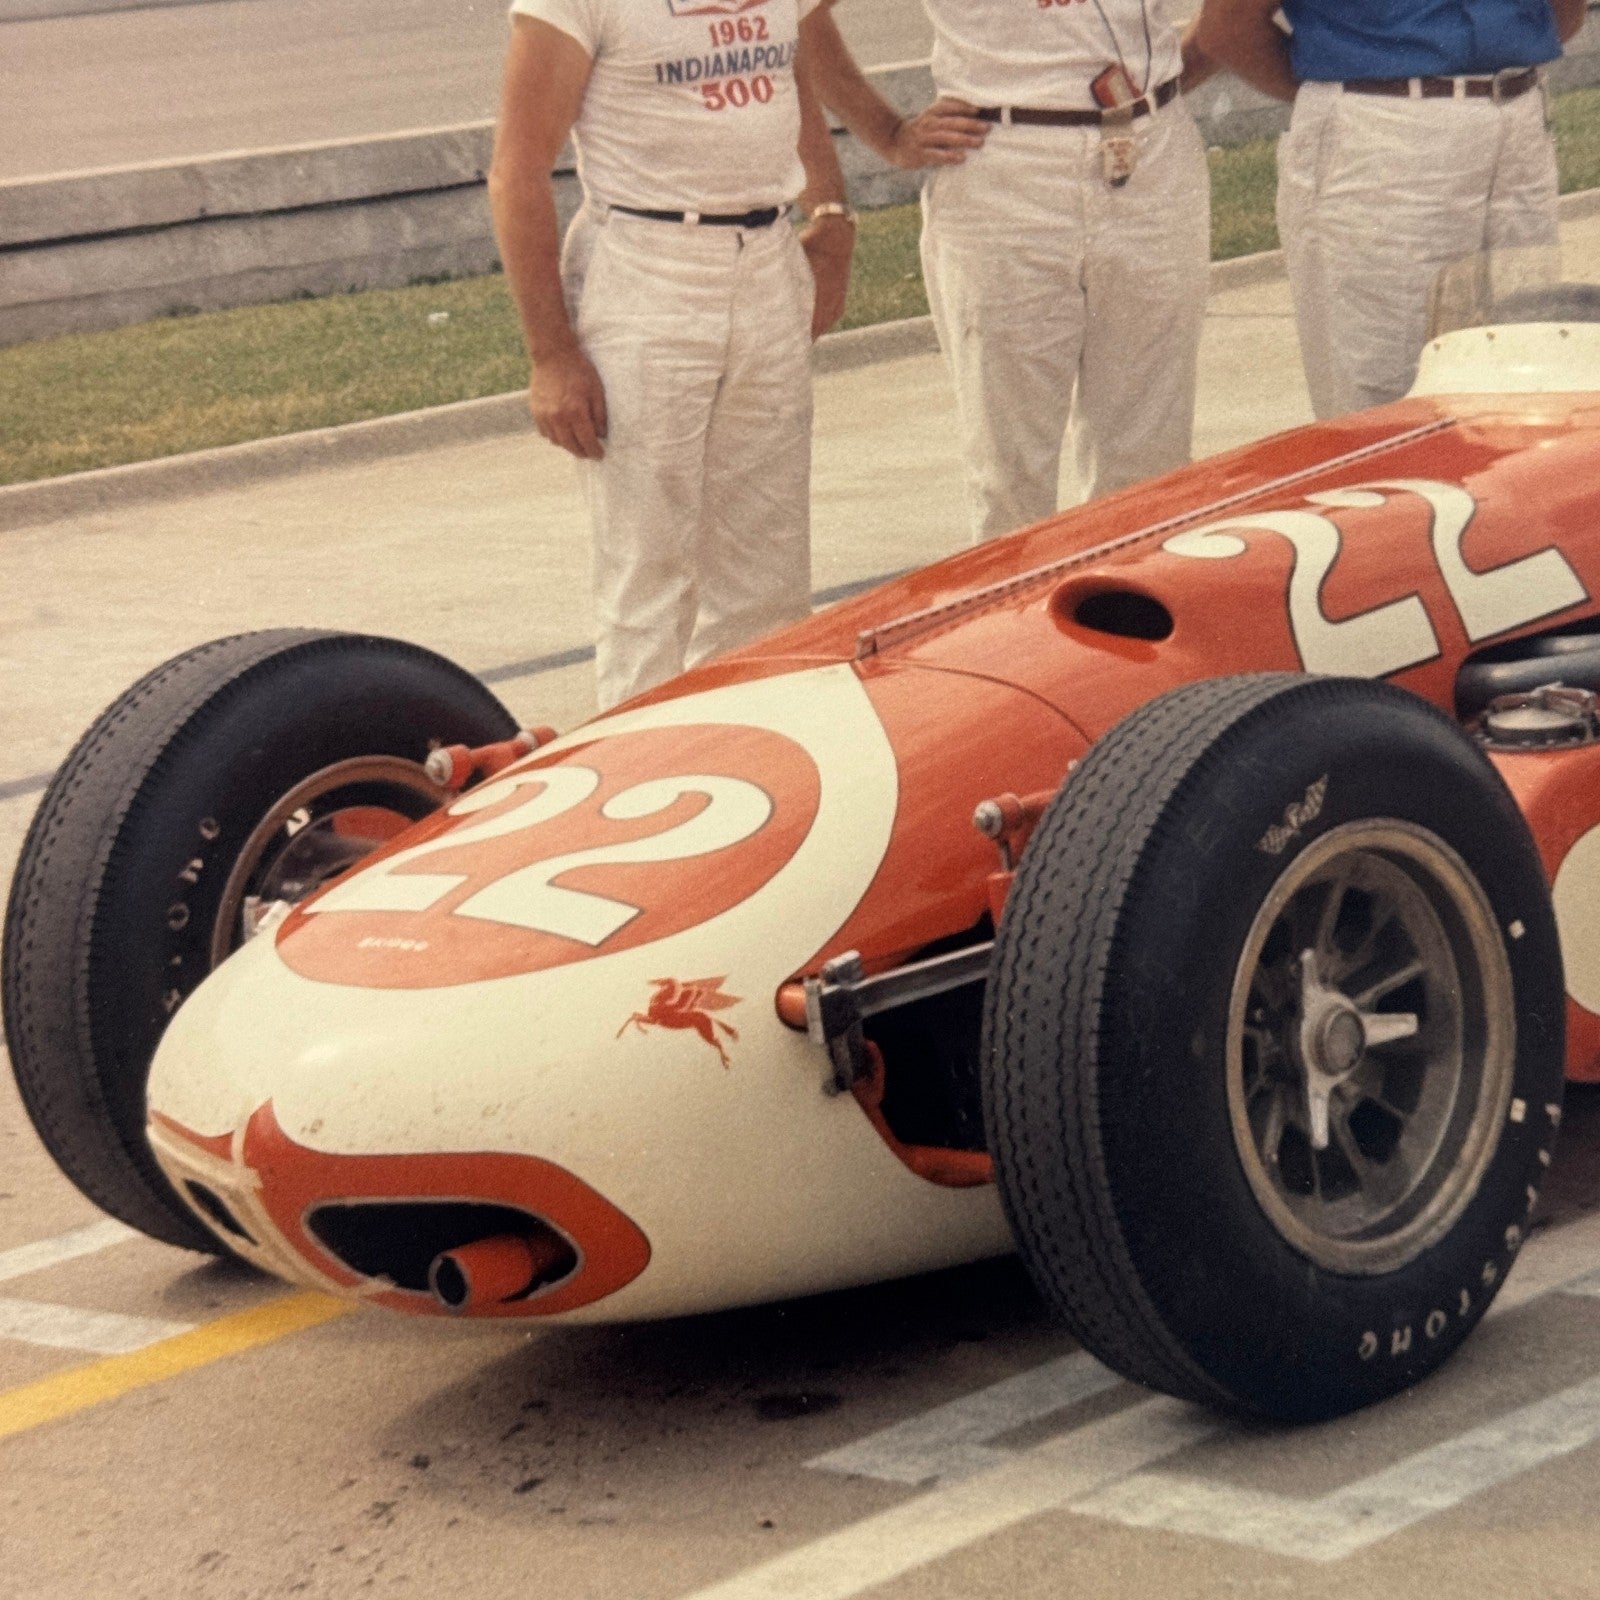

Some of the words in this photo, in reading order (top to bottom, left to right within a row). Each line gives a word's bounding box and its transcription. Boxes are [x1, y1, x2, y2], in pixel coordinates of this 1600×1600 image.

[655, 41, 799, 85] INDIANAPOLI
[709, 15, 769, 48] 1962
[1162, 478, 1590, 679] 22
[303, 765, 774, 948] 22
